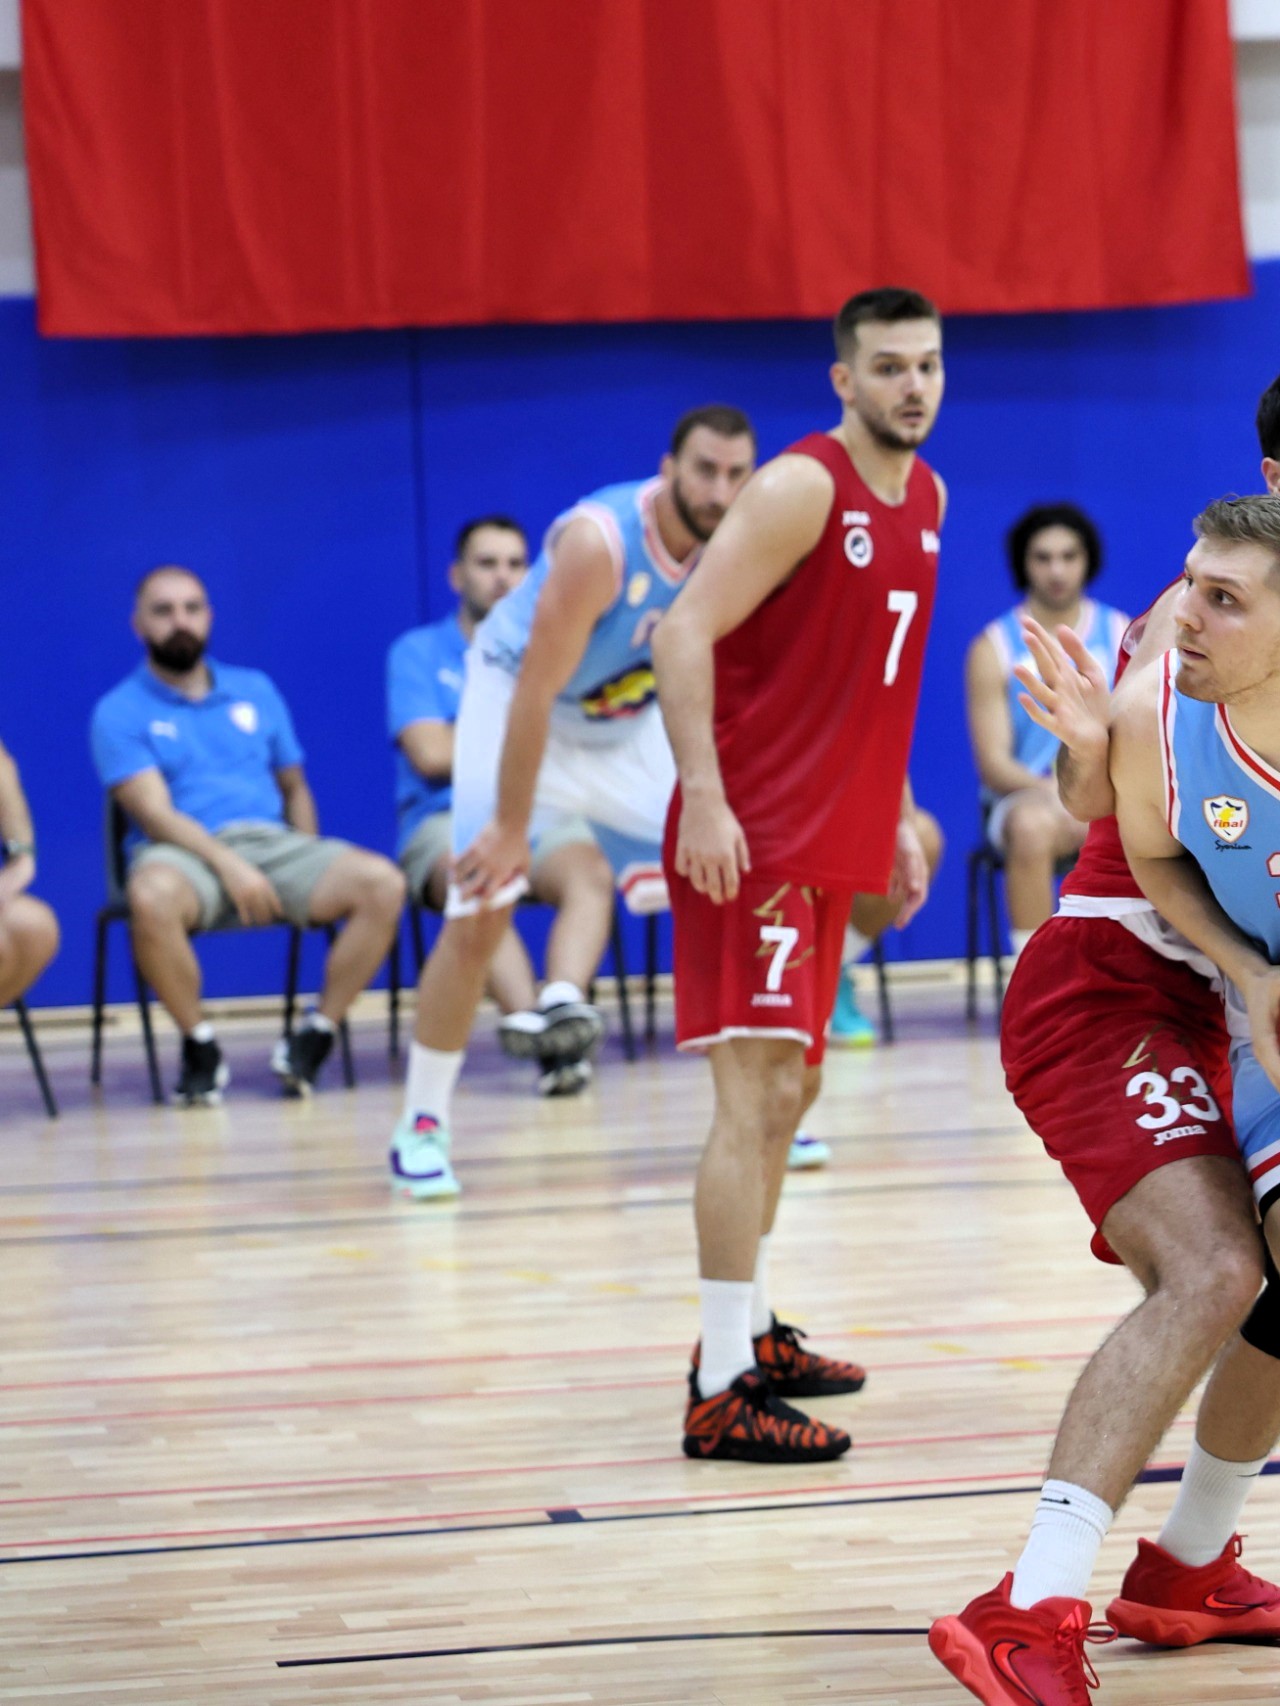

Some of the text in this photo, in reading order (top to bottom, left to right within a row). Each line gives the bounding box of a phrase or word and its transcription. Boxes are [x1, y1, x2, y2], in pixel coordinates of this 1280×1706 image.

[883, 589, 918, 686] 7
[1213, 819, 1244, 828] final
[759, 924, 799, 992] 7
[1125, 1066, 1221, 1130] 33
